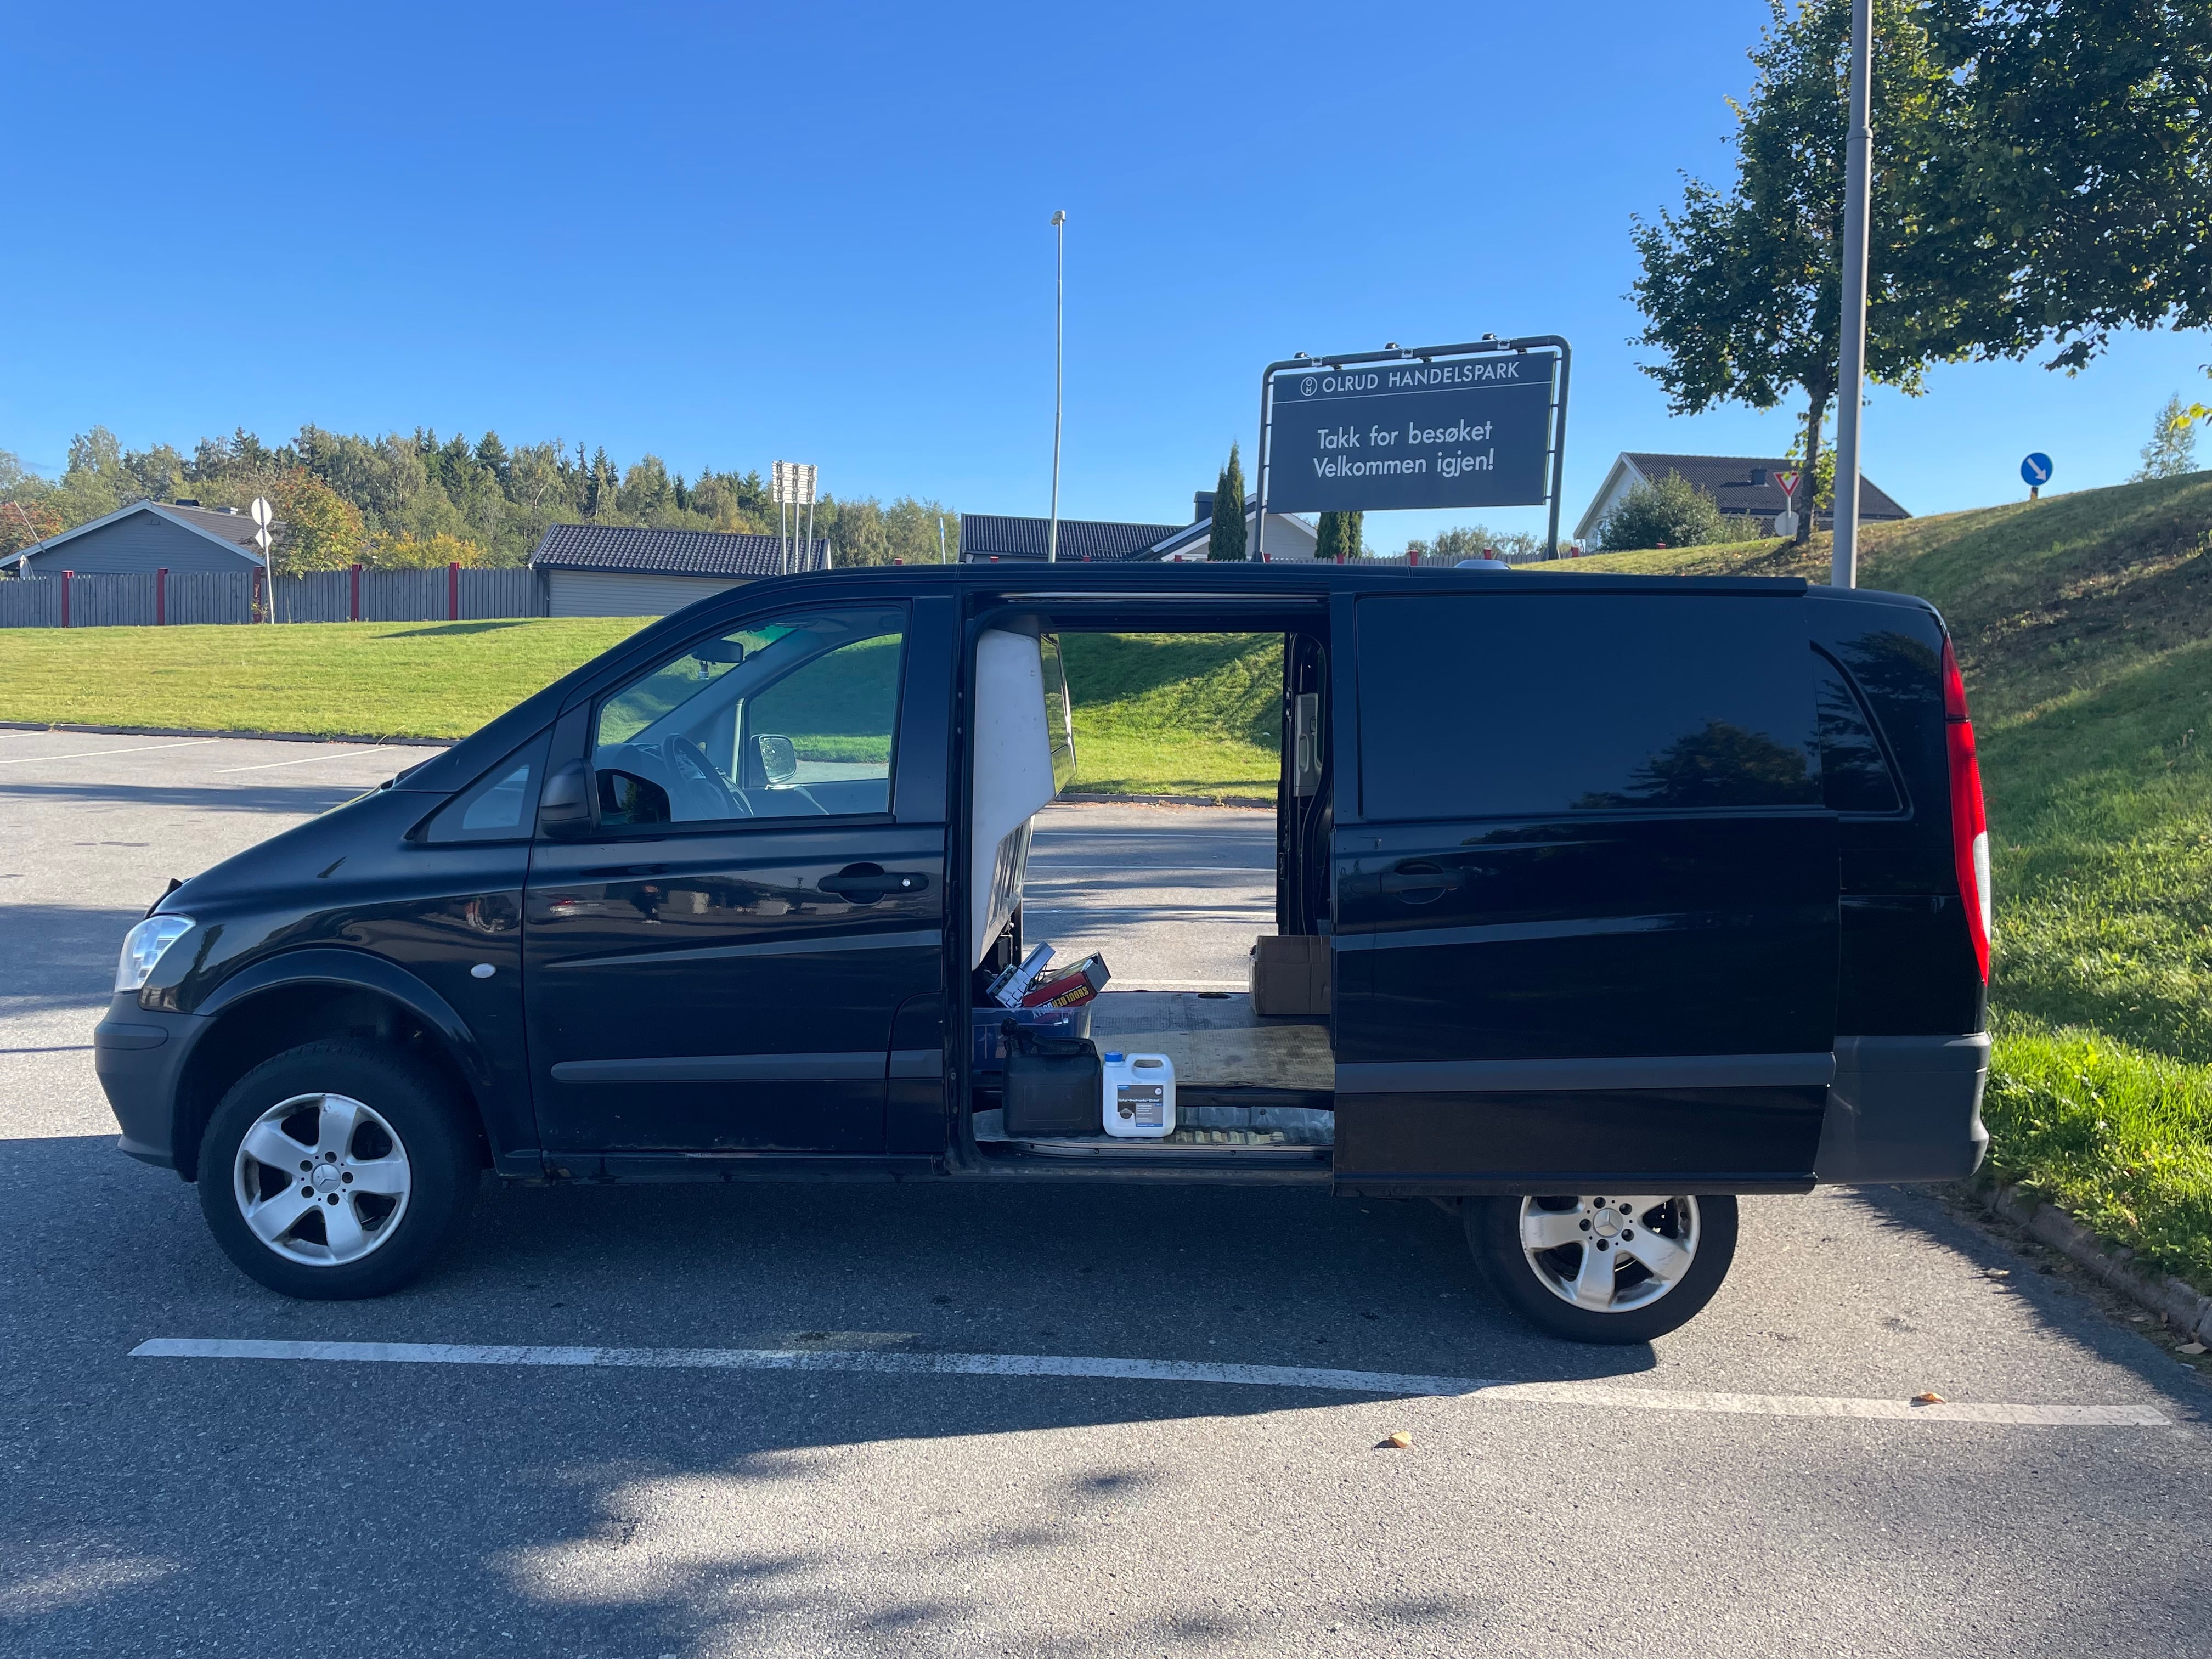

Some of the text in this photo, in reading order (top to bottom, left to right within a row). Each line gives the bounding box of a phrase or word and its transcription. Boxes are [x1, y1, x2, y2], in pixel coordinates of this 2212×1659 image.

[1323, 362, 1519, 392] OLRUD HANDELSPARK
[1318, 419, 1492, 449] Takk for besøket
[1313, 448, 1494, 478] Velkommen igjen!
